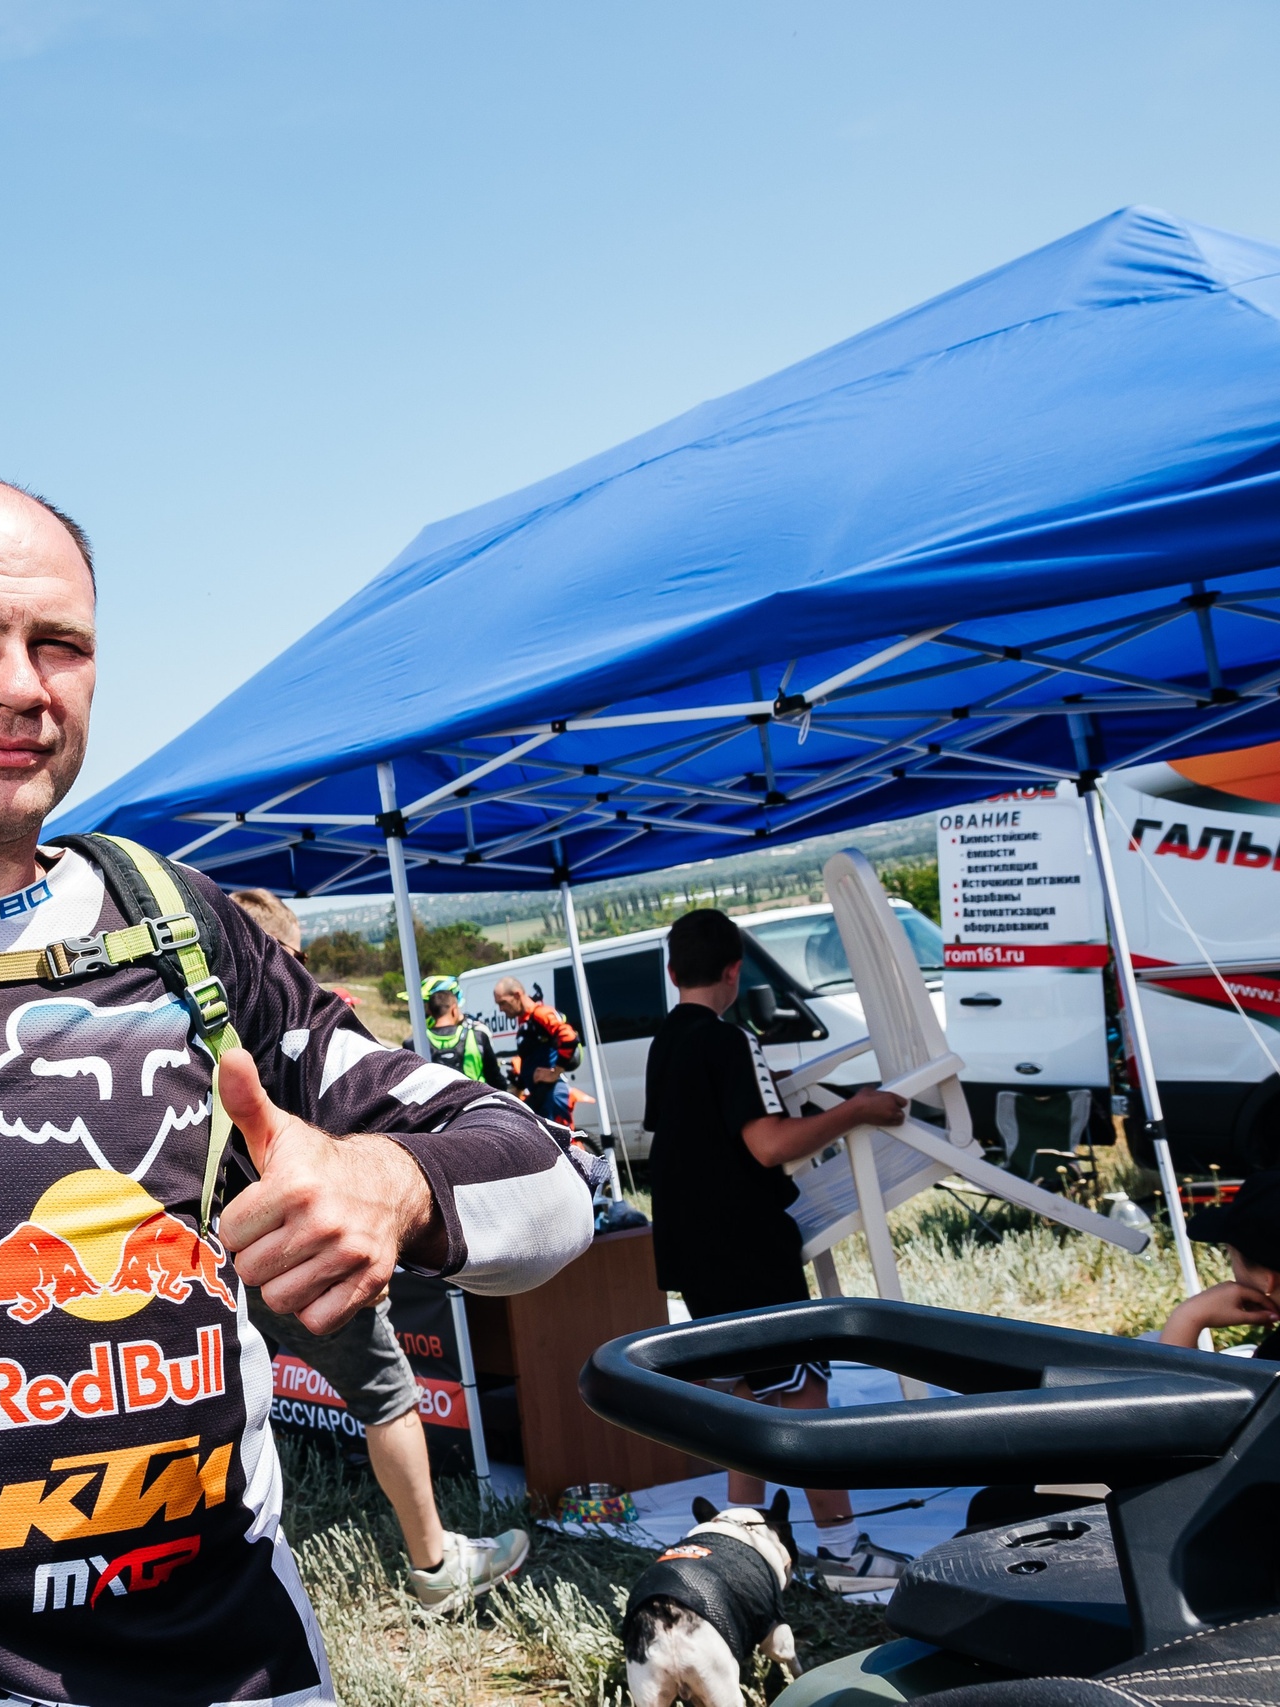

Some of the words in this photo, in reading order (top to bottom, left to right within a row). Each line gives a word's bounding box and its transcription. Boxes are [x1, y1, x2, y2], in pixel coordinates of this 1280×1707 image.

[940, 811, 1022, 831] ОВАНИЕ
[1128, 818, 1280, 873] ГАЛЬ
[1026, 874, 1081, 886] питания
[962, 906, 1056, 919] Автоматизация
[964, 921, 1050, 934] оборудования
[944, 946, 1025, 963] rom161.ru
[119, 1324, 225, 1413] Bull
